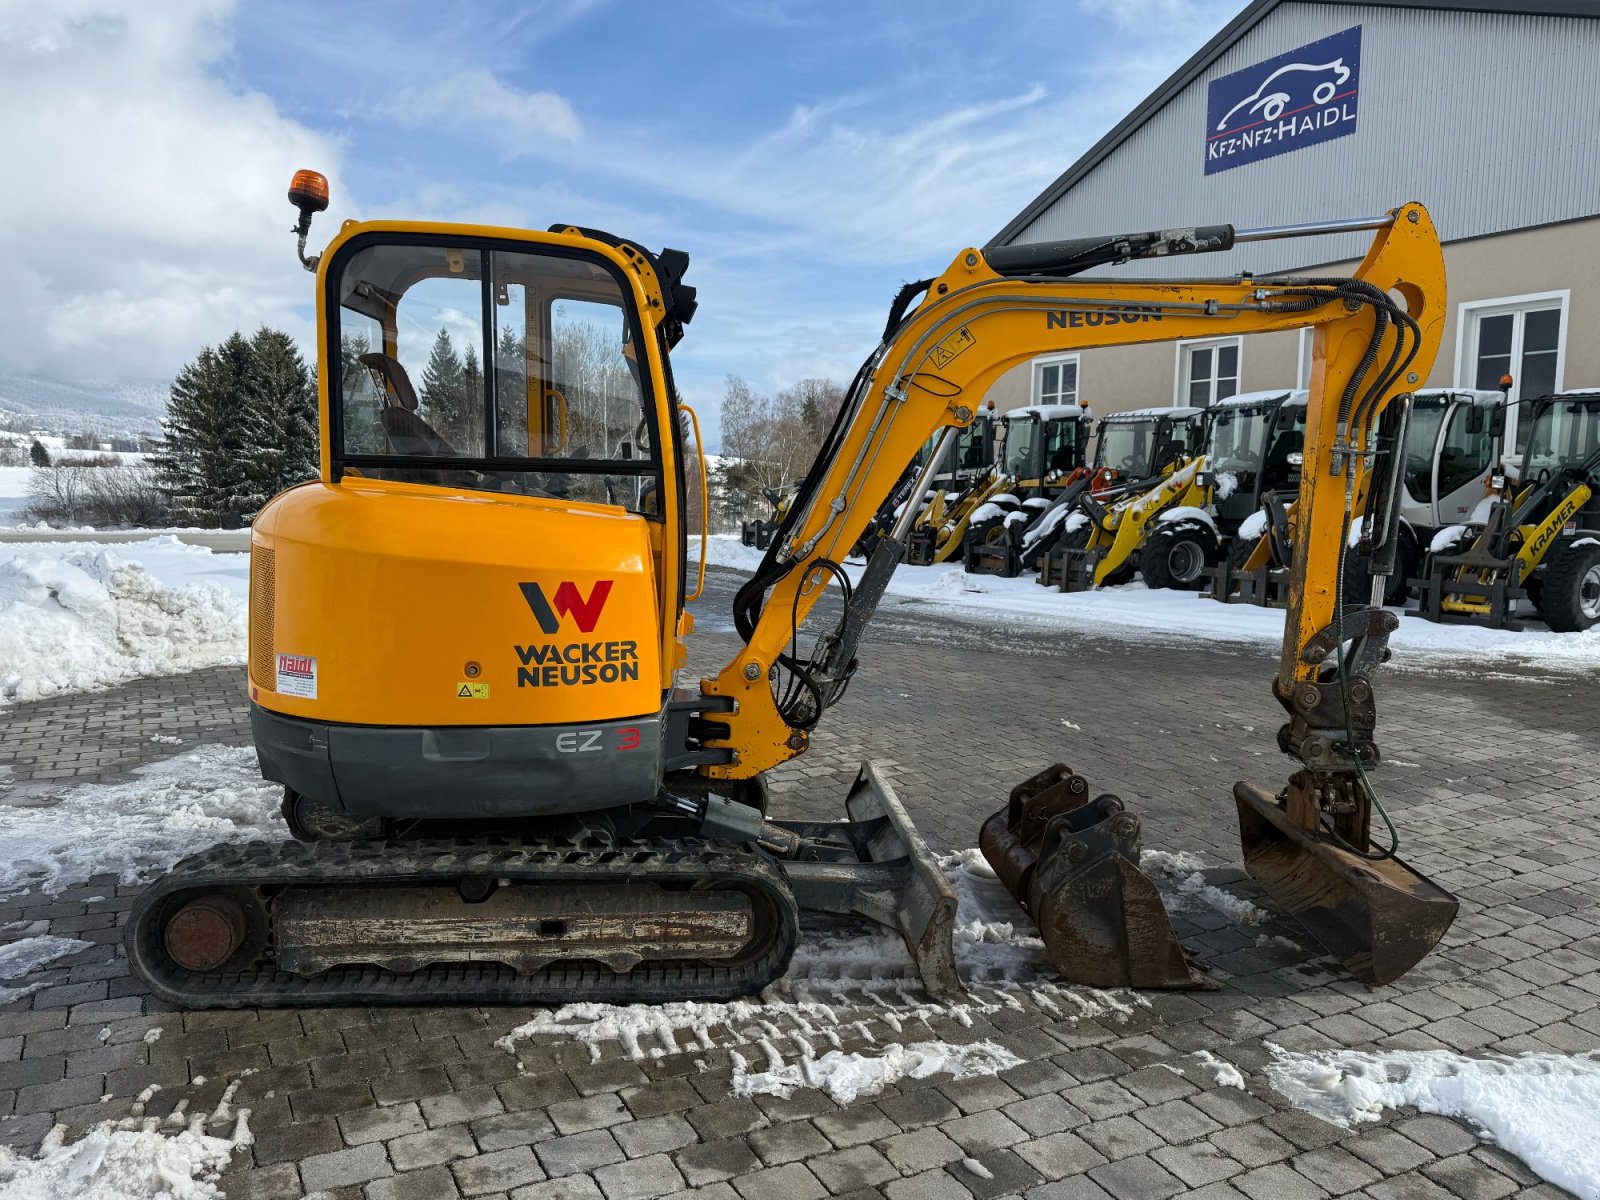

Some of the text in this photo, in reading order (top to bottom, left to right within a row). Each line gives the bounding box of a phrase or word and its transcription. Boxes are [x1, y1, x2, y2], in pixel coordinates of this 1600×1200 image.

[1046, 306, 1163, 330] NEUSON
[897, 476, 916, 500] TEREX
[1529, 500, 1576, 557] KRAMER
[513, 640, 639, 666] WACKER
[517, 661, 639, 688] NEUSON
[556, 728, 641, 753] EZ 3
